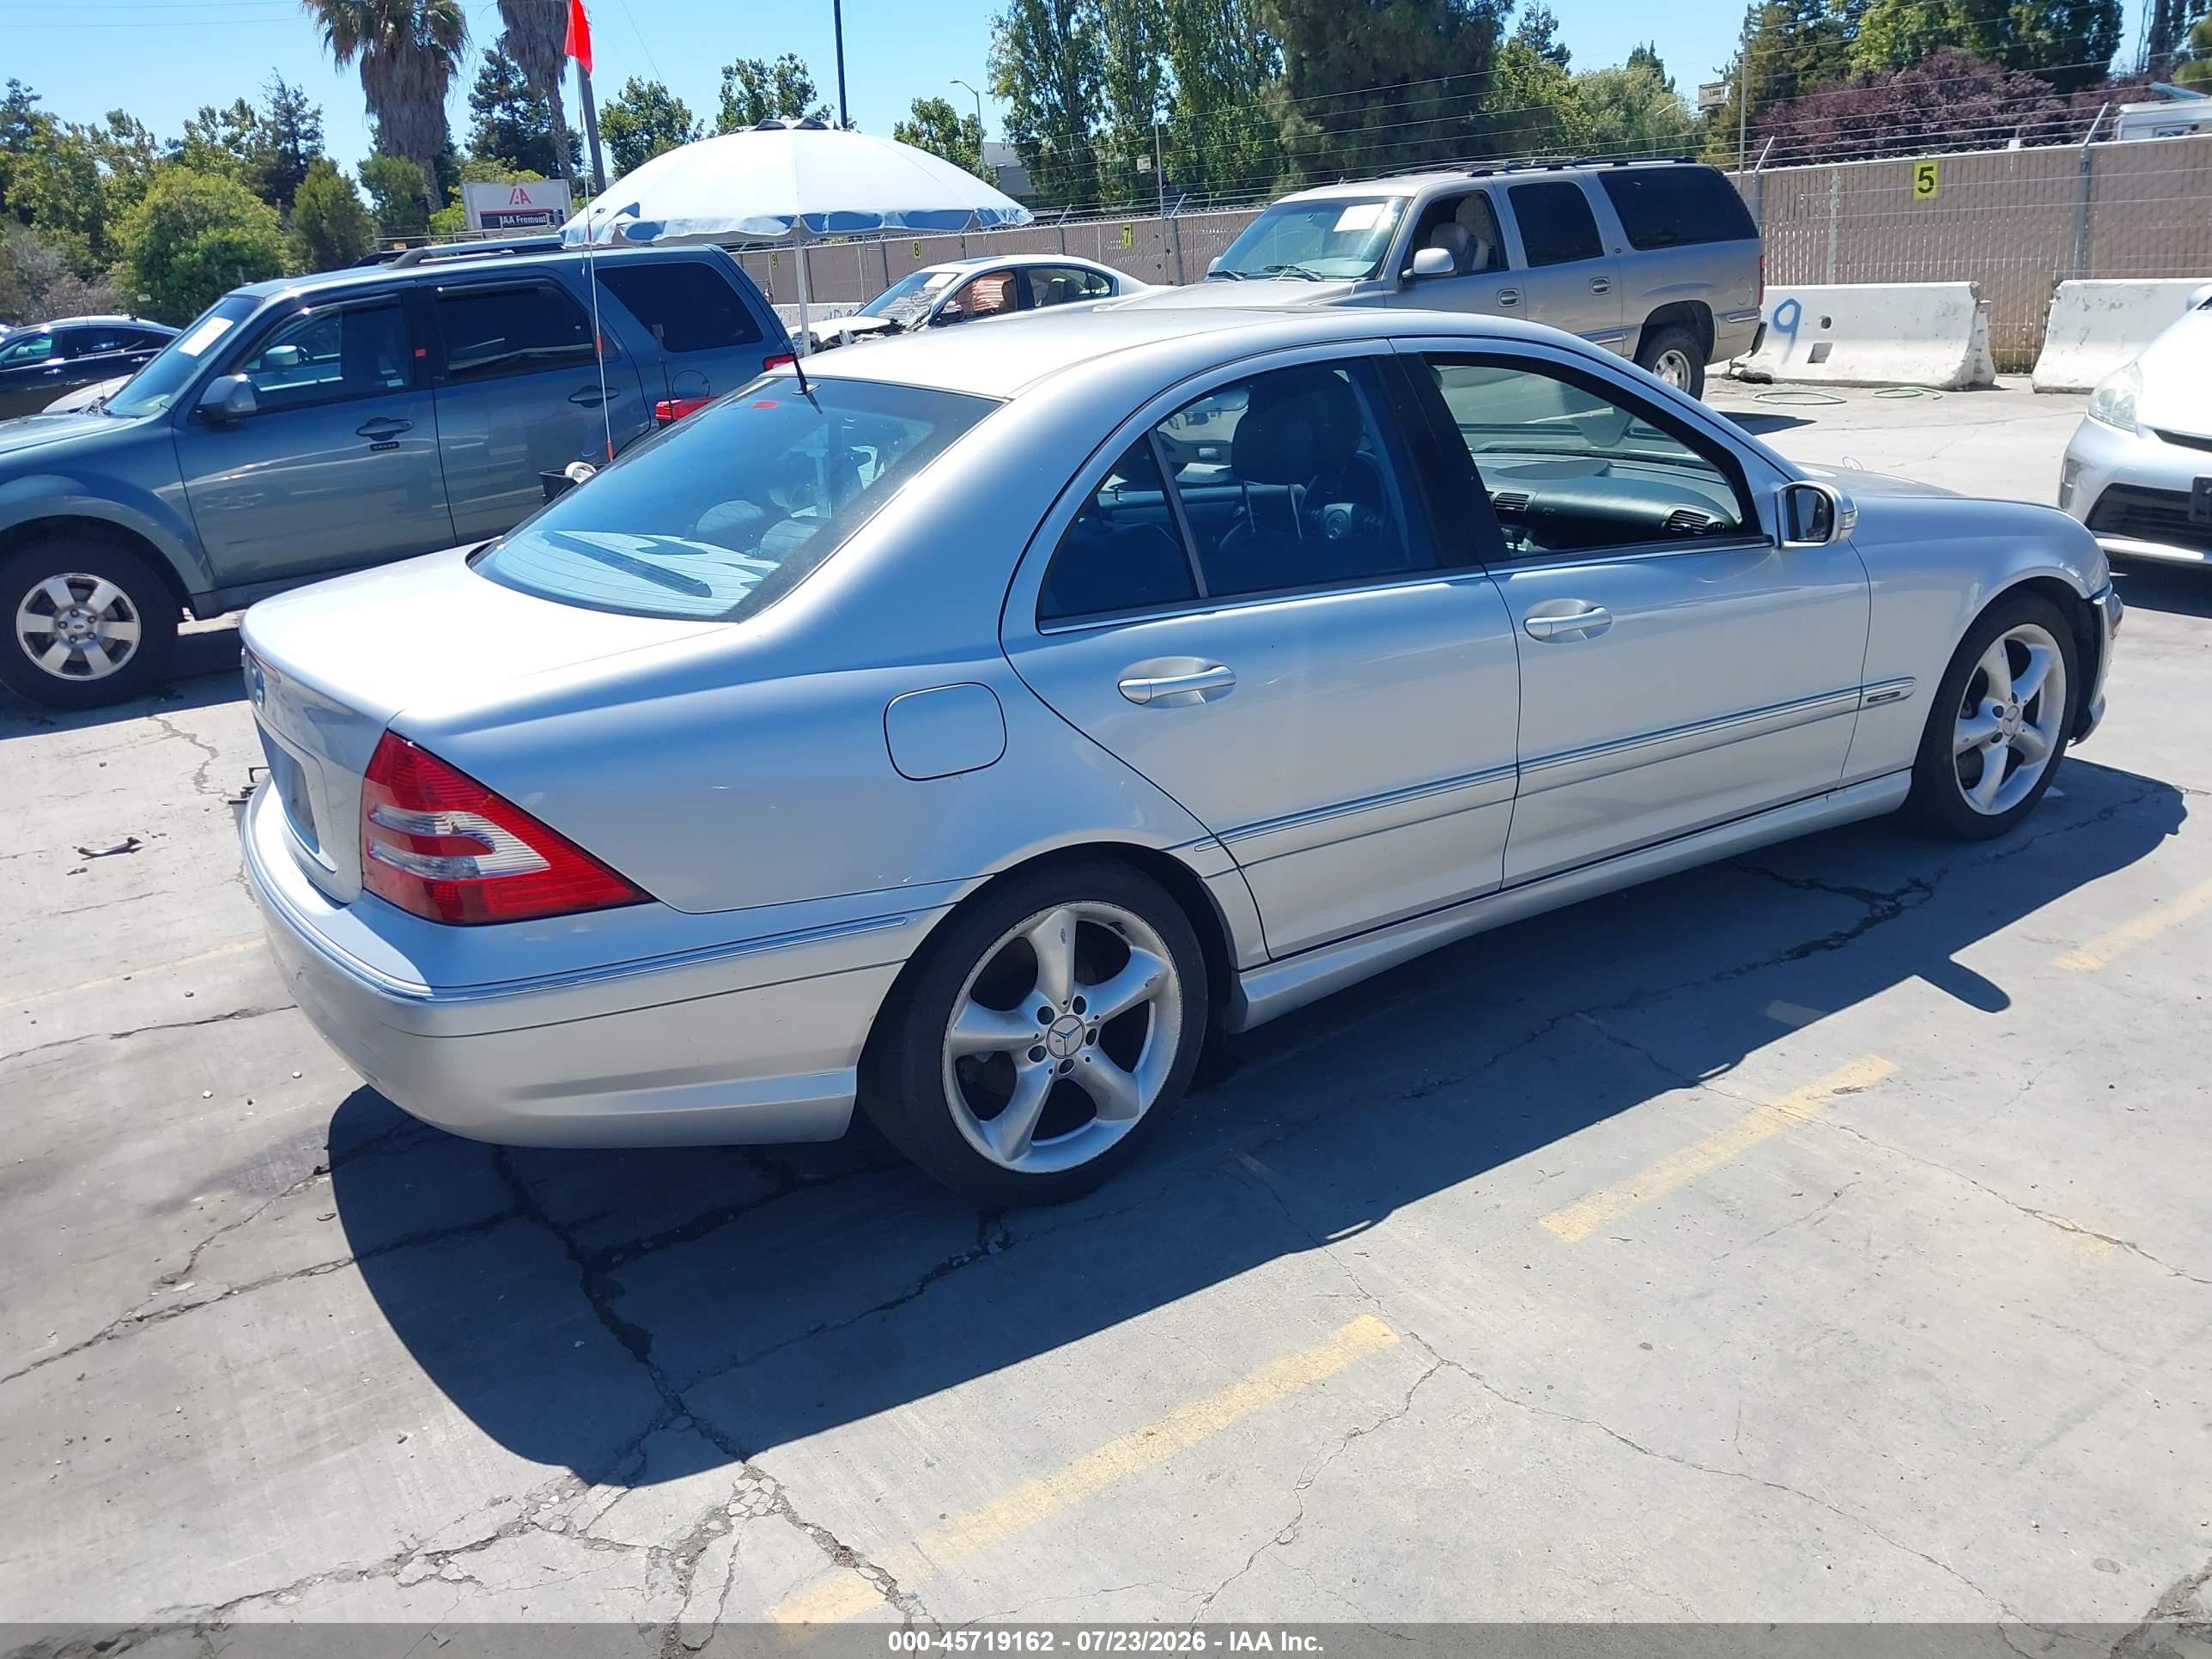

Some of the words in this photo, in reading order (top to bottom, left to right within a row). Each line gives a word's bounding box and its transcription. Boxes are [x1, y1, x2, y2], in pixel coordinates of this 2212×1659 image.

[1917, 166, 1936, 194] 5
[1124, 227, 1130, 244] 7
[914, 242, 920, 257] 8
[1773, 298, 1802, 363] 9
